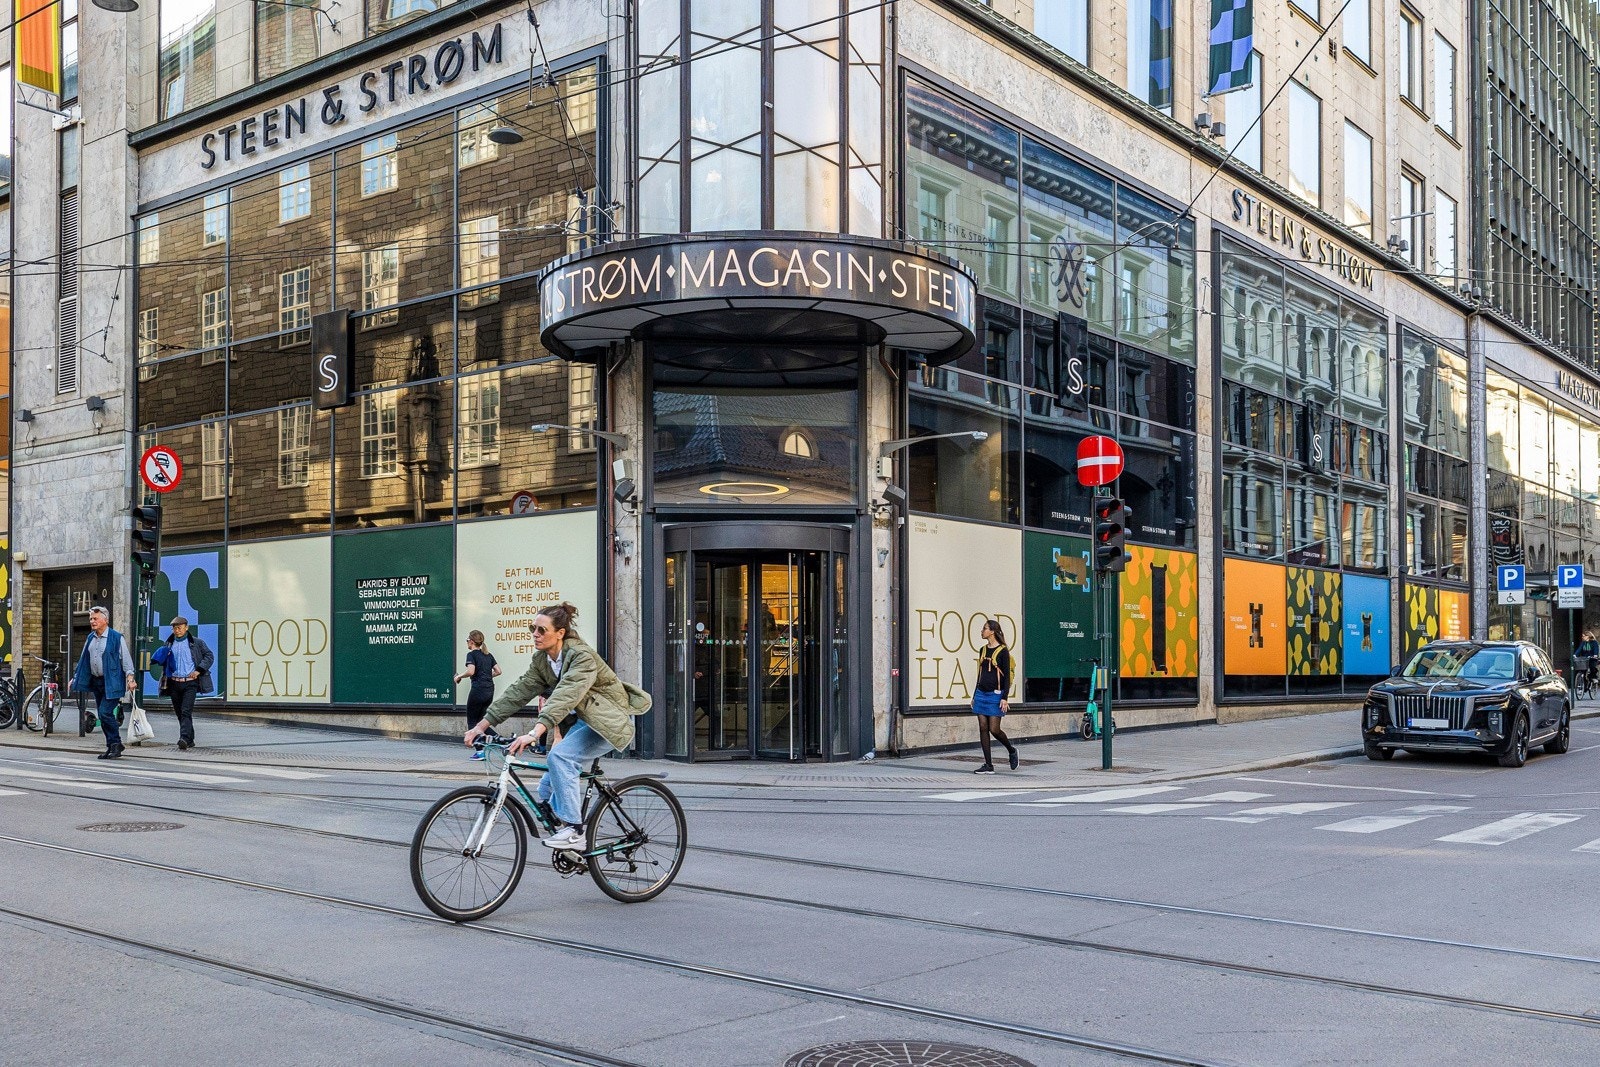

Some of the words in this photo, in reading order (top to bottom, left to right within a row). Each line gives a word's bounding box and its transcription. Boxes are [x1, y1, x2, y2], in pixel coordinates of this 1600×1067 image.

[201, 98, 305, 169] STEEN
[320, 85, 345, 126] &
[359, 22, 502, 113] STRØM
[1232, 188, 1295, 249] STEEN
[1301, 227, 1313, 260] &
[1318, 237, 1374, 291] STRØM
[555, 254, 661, 313] STRØM
[681, 247, 873, 293] MAGASIN
[891, 259, 966, 317] STEEN
[319, 355, 338, 392] S
[1067, 358, 1083, 395] S
[1313, 434, 1323, 462] S
[505, 568, 521, 578] EAT
[525, 566, 544, 577] THAI
[1504, 569, 1518, 588] P
[1564, 568, 1577, 586] P
[357, 579, 387, 589] LAKRIDS
[389, 578, 399, 587] BY
[401, 576, 428, 586] BÜLOW
[497, 581, 512, 591] FLY
[515, 579, 552, 590] CHICKEN
[358, 588, 398, 599] SEBASTIEN
[400, 587, 426, 597] BRUNO
[490, 595, 505, 604] JOE
[508, 594, 513, 603] &
[516, 593, 532, 602] THE
[536, 591, 560, 601] JUICE
[364, 599, 420, 610] VINMONOPOLET
[360, 611, 399, 622] JONATHAN
[401, 610, 423, 620] SUSHI
[365, 624, 395, 633] MAMMA
[397, 623, 418, 632] PIZZA
[230, 618, 327, 656] FOOD
[368, 635, 414, 645] MATKROKEN
[495, 632, 531, 642] OLIVIERS
[514, 644, 534, 654] LETT
[230, 660, 327, 698] HALL
[915, 657, 1017, 699] HA
